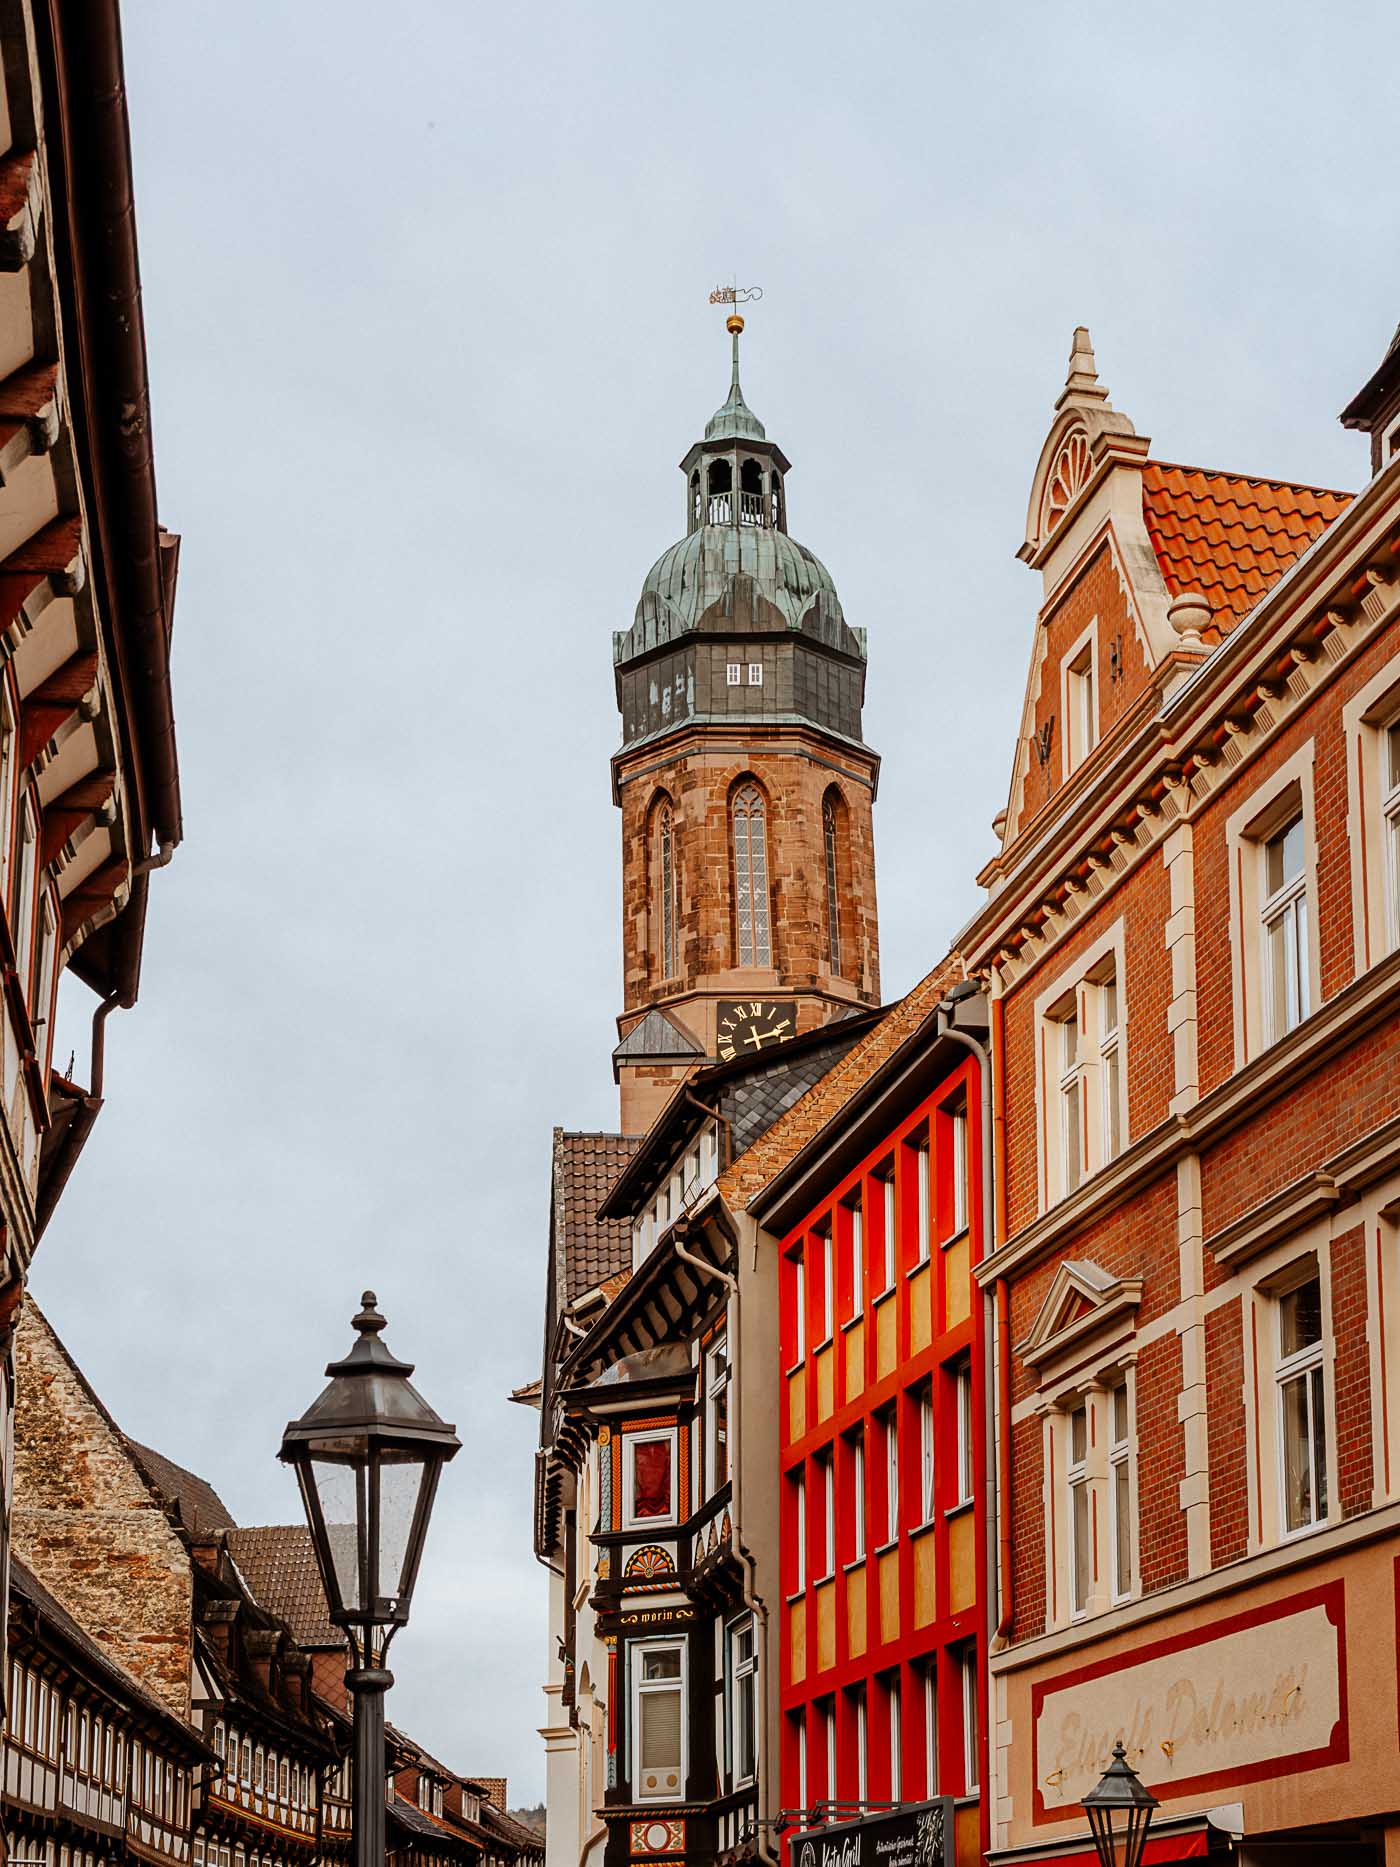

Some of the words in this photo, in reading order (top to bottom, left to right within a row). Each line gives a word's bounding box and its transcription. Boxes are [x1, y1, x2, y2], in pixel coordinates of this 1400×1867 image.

[733, 1006, 748, 1021] XI
[750, 1003, 762, 1016] XII
[767, 1007, 777, 1020] I
[722, 1018, 737, 1030] X
[718, 1034, 733, 1044] IX
